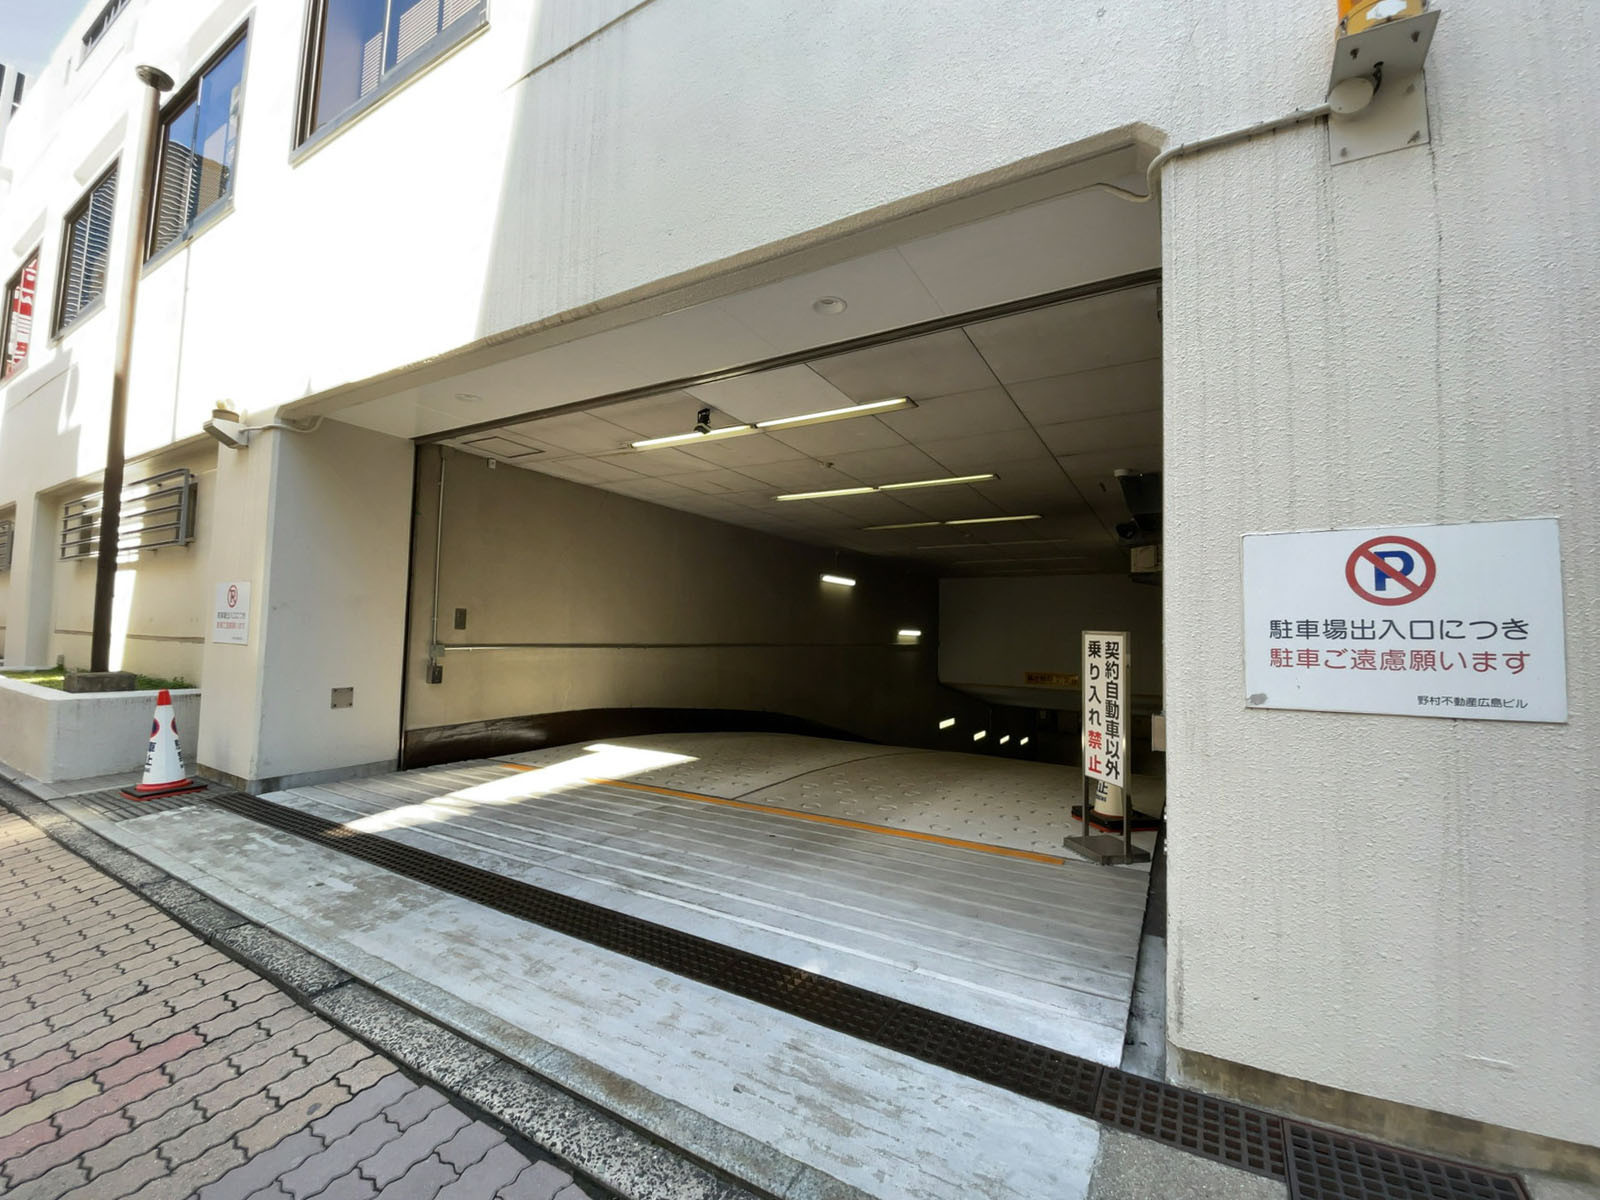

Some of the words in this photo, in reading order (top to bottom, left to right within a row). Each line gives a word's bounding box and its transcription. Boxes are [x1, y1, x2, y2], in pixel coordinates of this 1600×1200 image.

[1269, 618, 1529, 640] 駐車場出入口につき
[1269, 647, 1531, 674] 駐車ご遠慮願います
[1088, 640, 1102, 774] 乗り入れ禁止
[1105, 641, 1120, 780] 契約自動車以外
[1417, 695, 1528, 708] 野村不動産広島ビル
